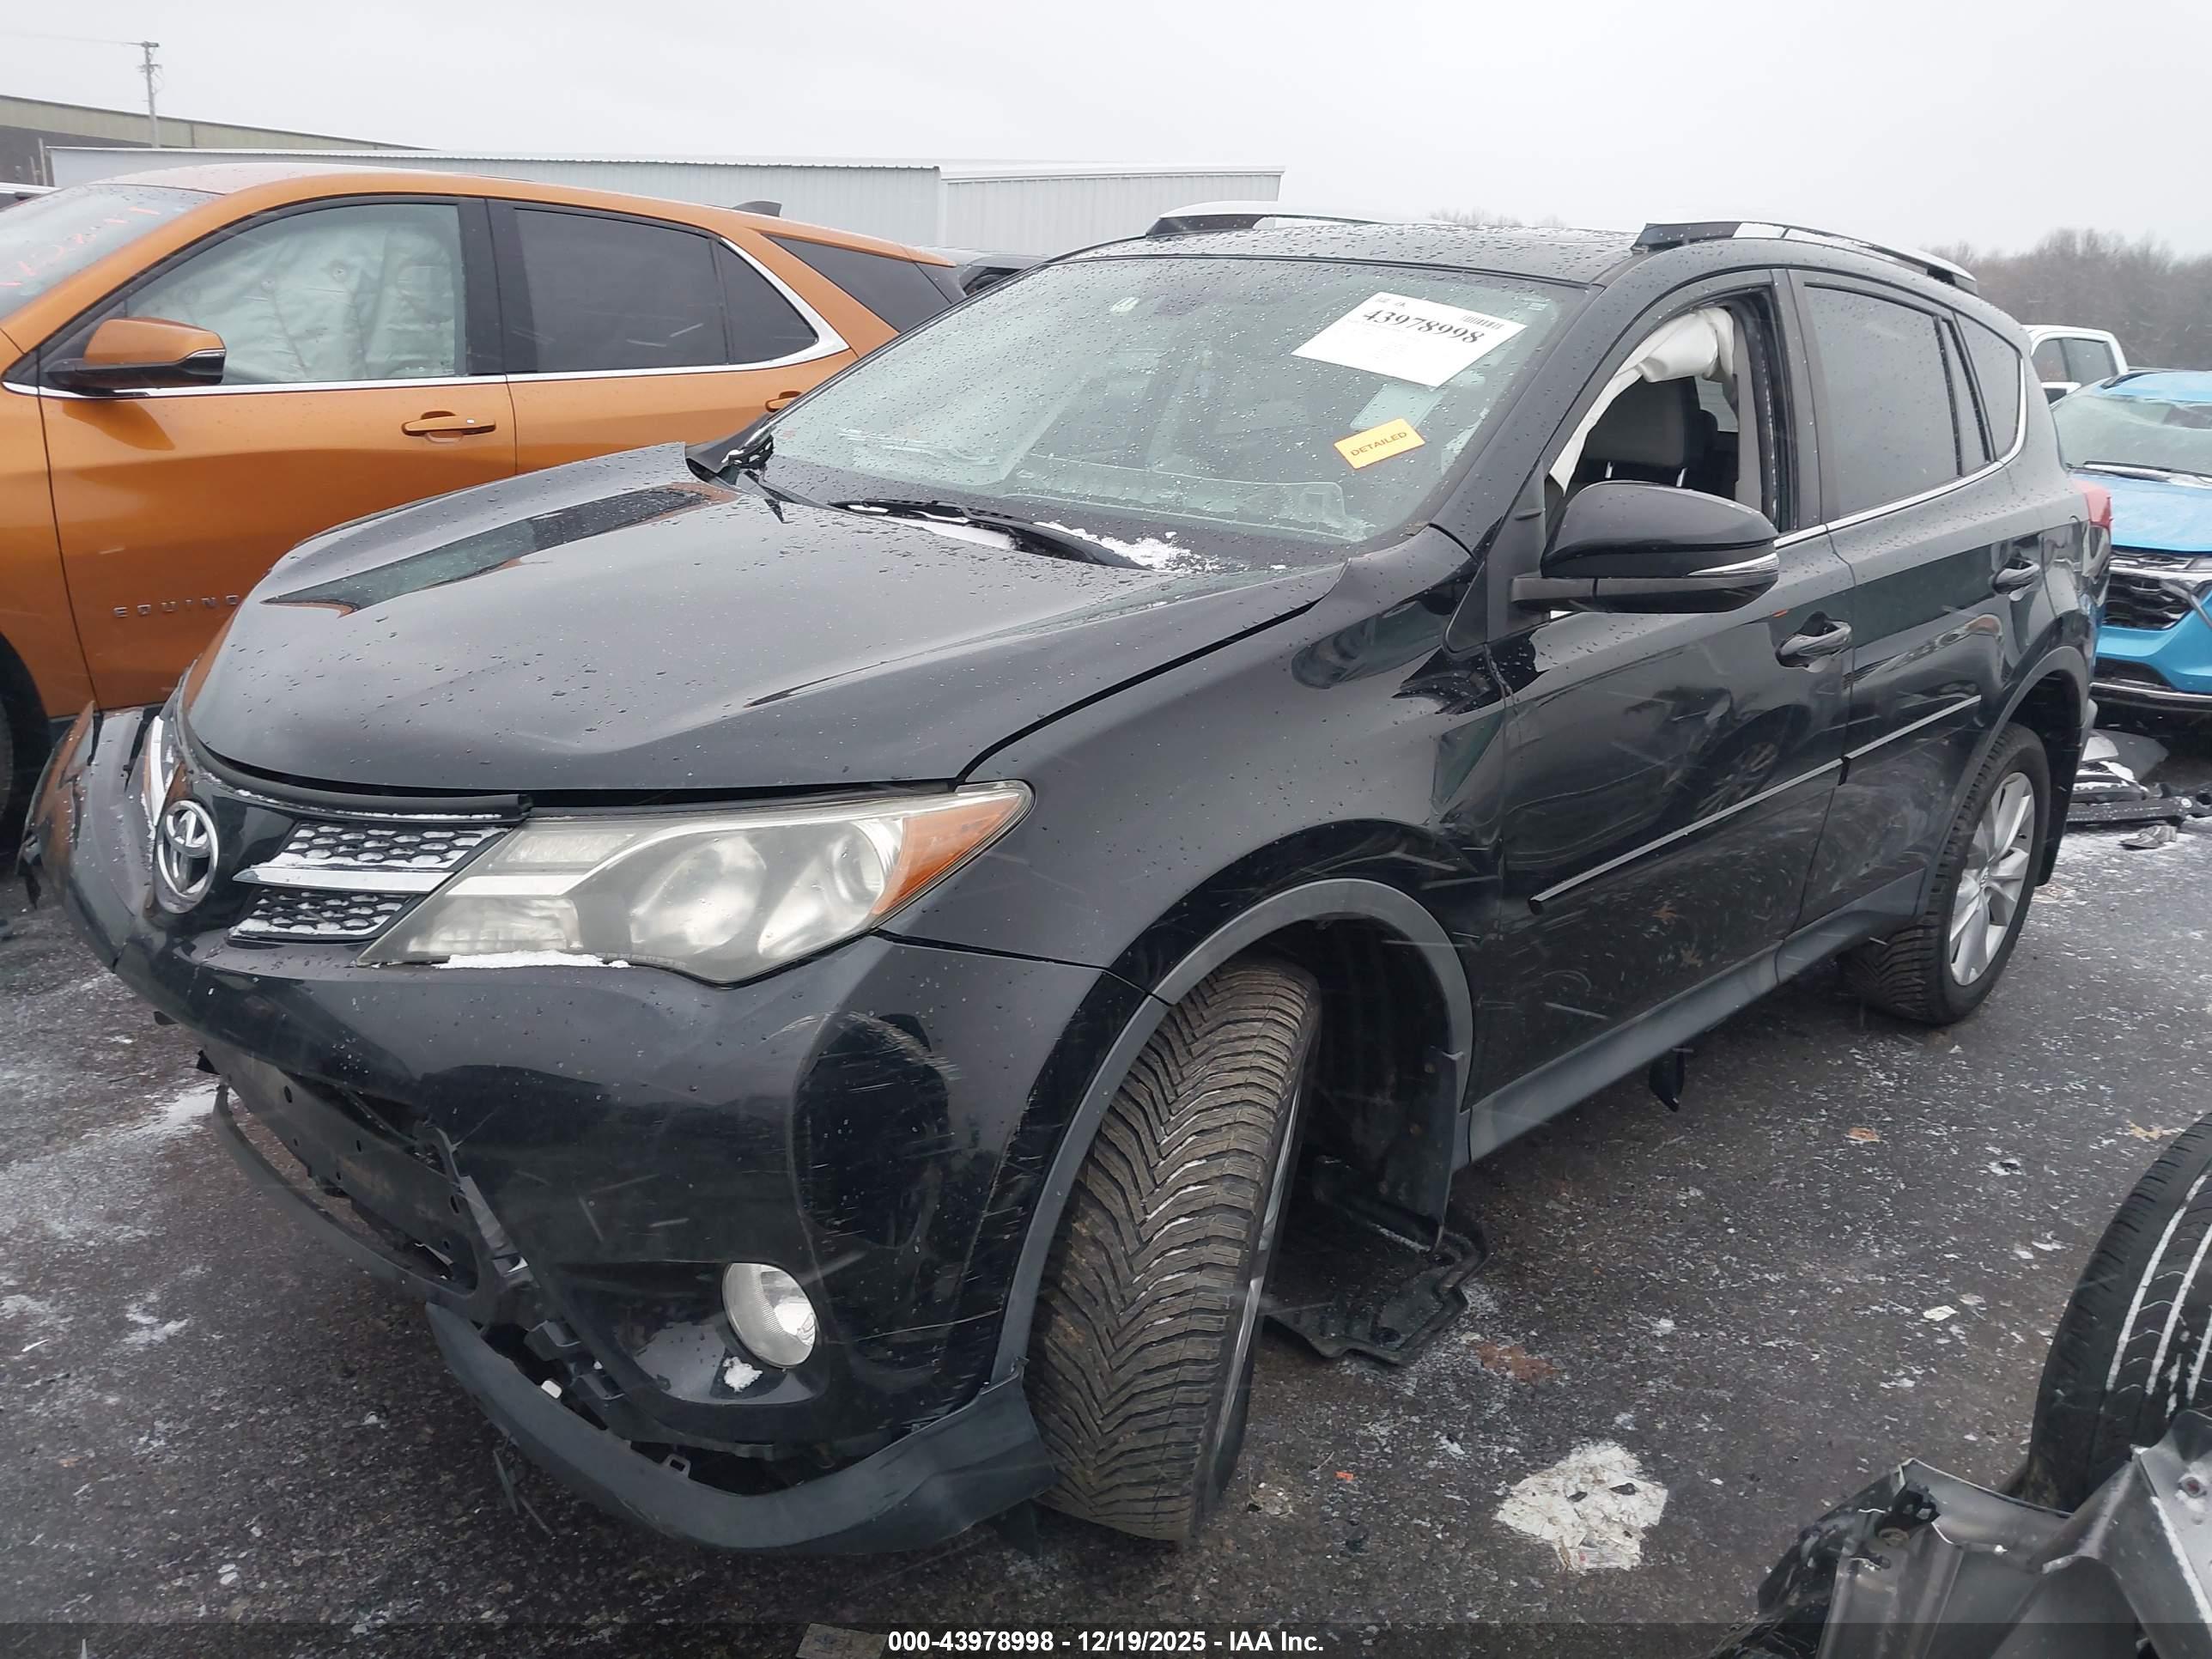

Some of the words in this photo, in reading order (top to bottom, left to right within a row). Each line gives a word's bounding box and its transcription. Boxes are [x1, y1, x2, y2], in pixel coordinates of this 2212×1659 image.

[1363, 309, 1485, 343] 43978998
[1350, 432, 1407, 457] DETAILED
[113, 594, 240, 618] EQUINO
